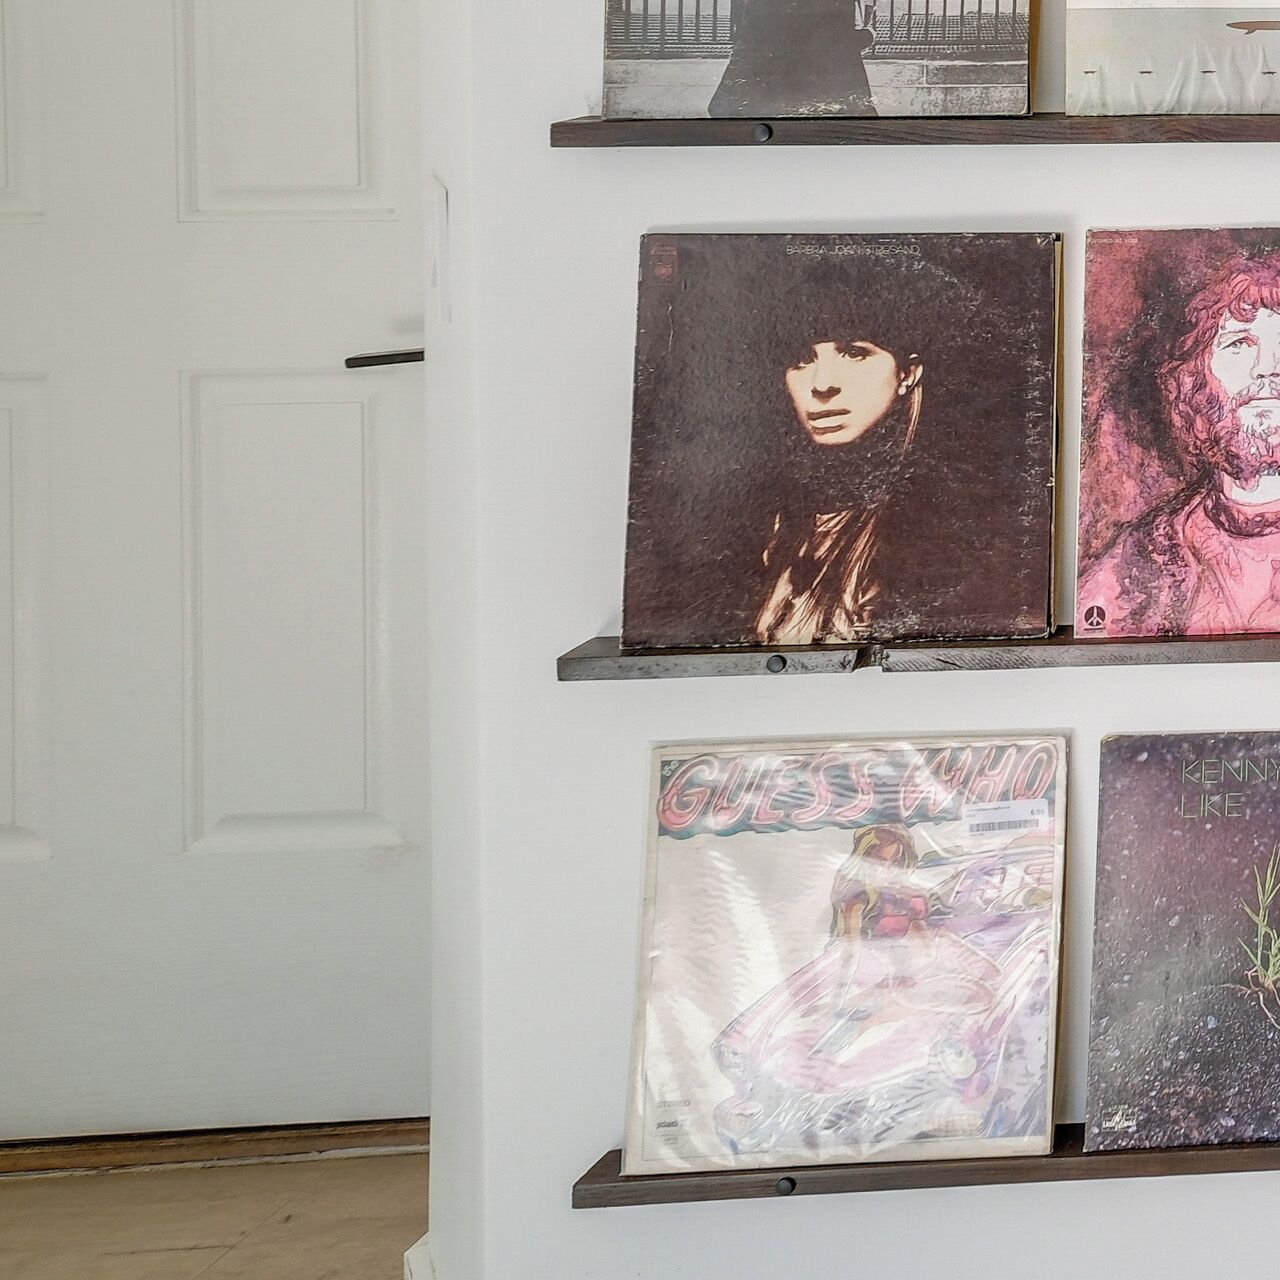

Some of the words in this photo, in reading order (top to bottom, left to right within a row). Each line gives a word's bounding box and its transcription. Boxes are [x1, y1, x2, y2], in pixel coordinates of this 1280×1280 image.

[657, 750, 875, 831] GUESS
[899, 742, 1059, 821] WHO
[1181, 792, 1244, 819] LIKE
